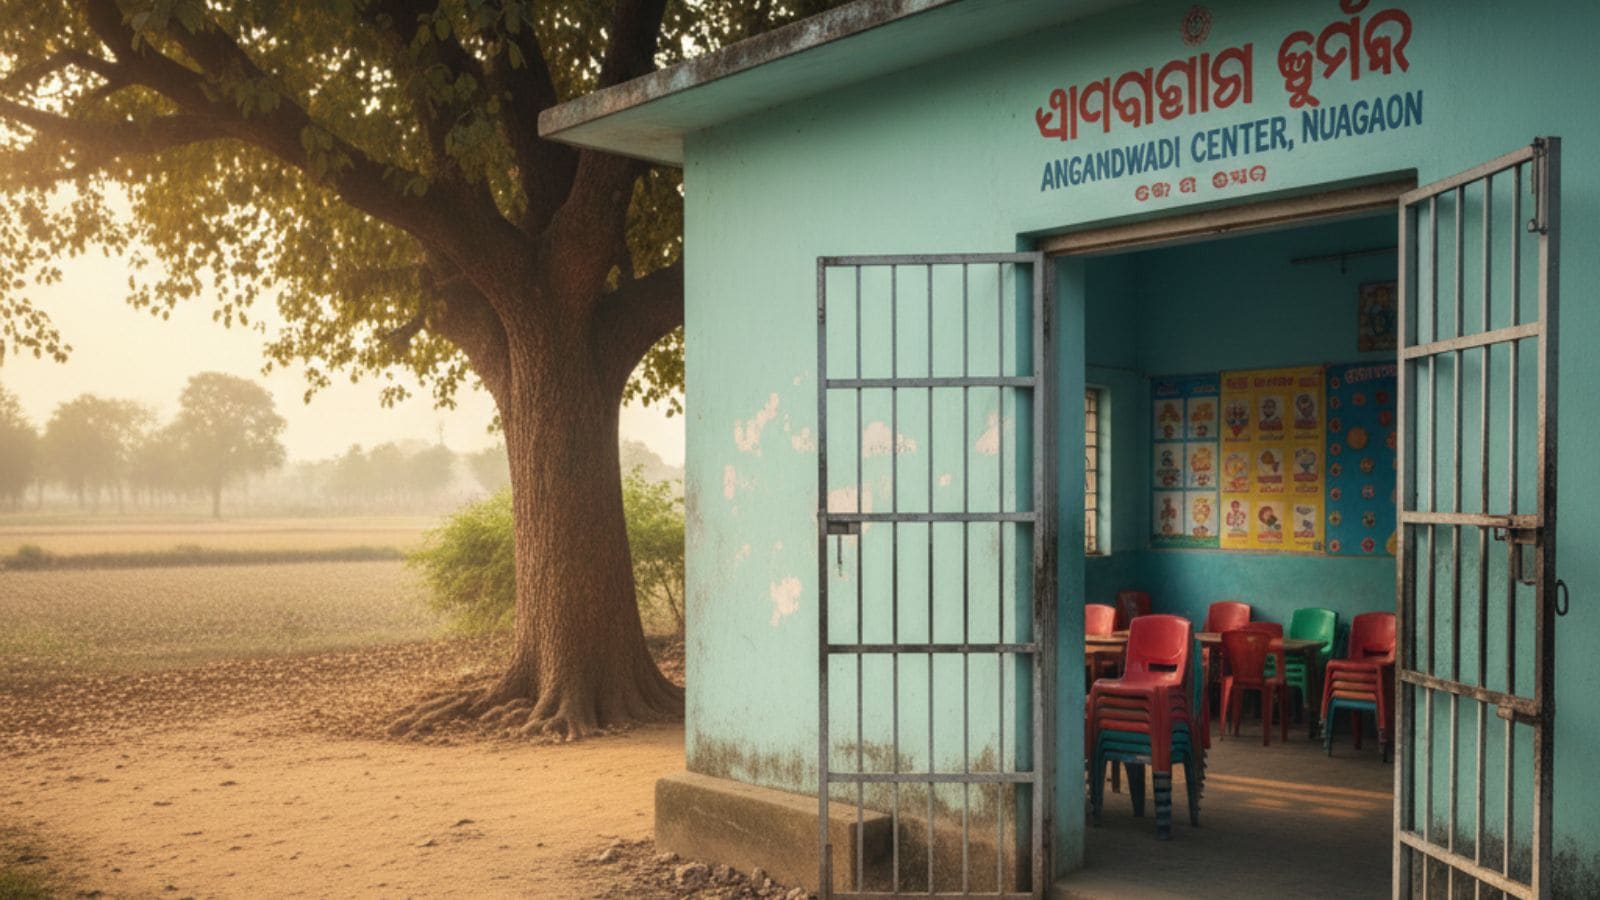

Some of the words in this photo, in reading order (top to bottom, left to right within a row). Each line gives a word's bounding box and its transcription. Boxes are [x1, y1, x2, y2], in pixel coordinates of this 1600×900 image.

[1041, 137, 1181, 191] ANGANDWADI
[1191, 116, 1294, 163] CENTER,
[1303, 90, 1423, 144] NUAGAON
